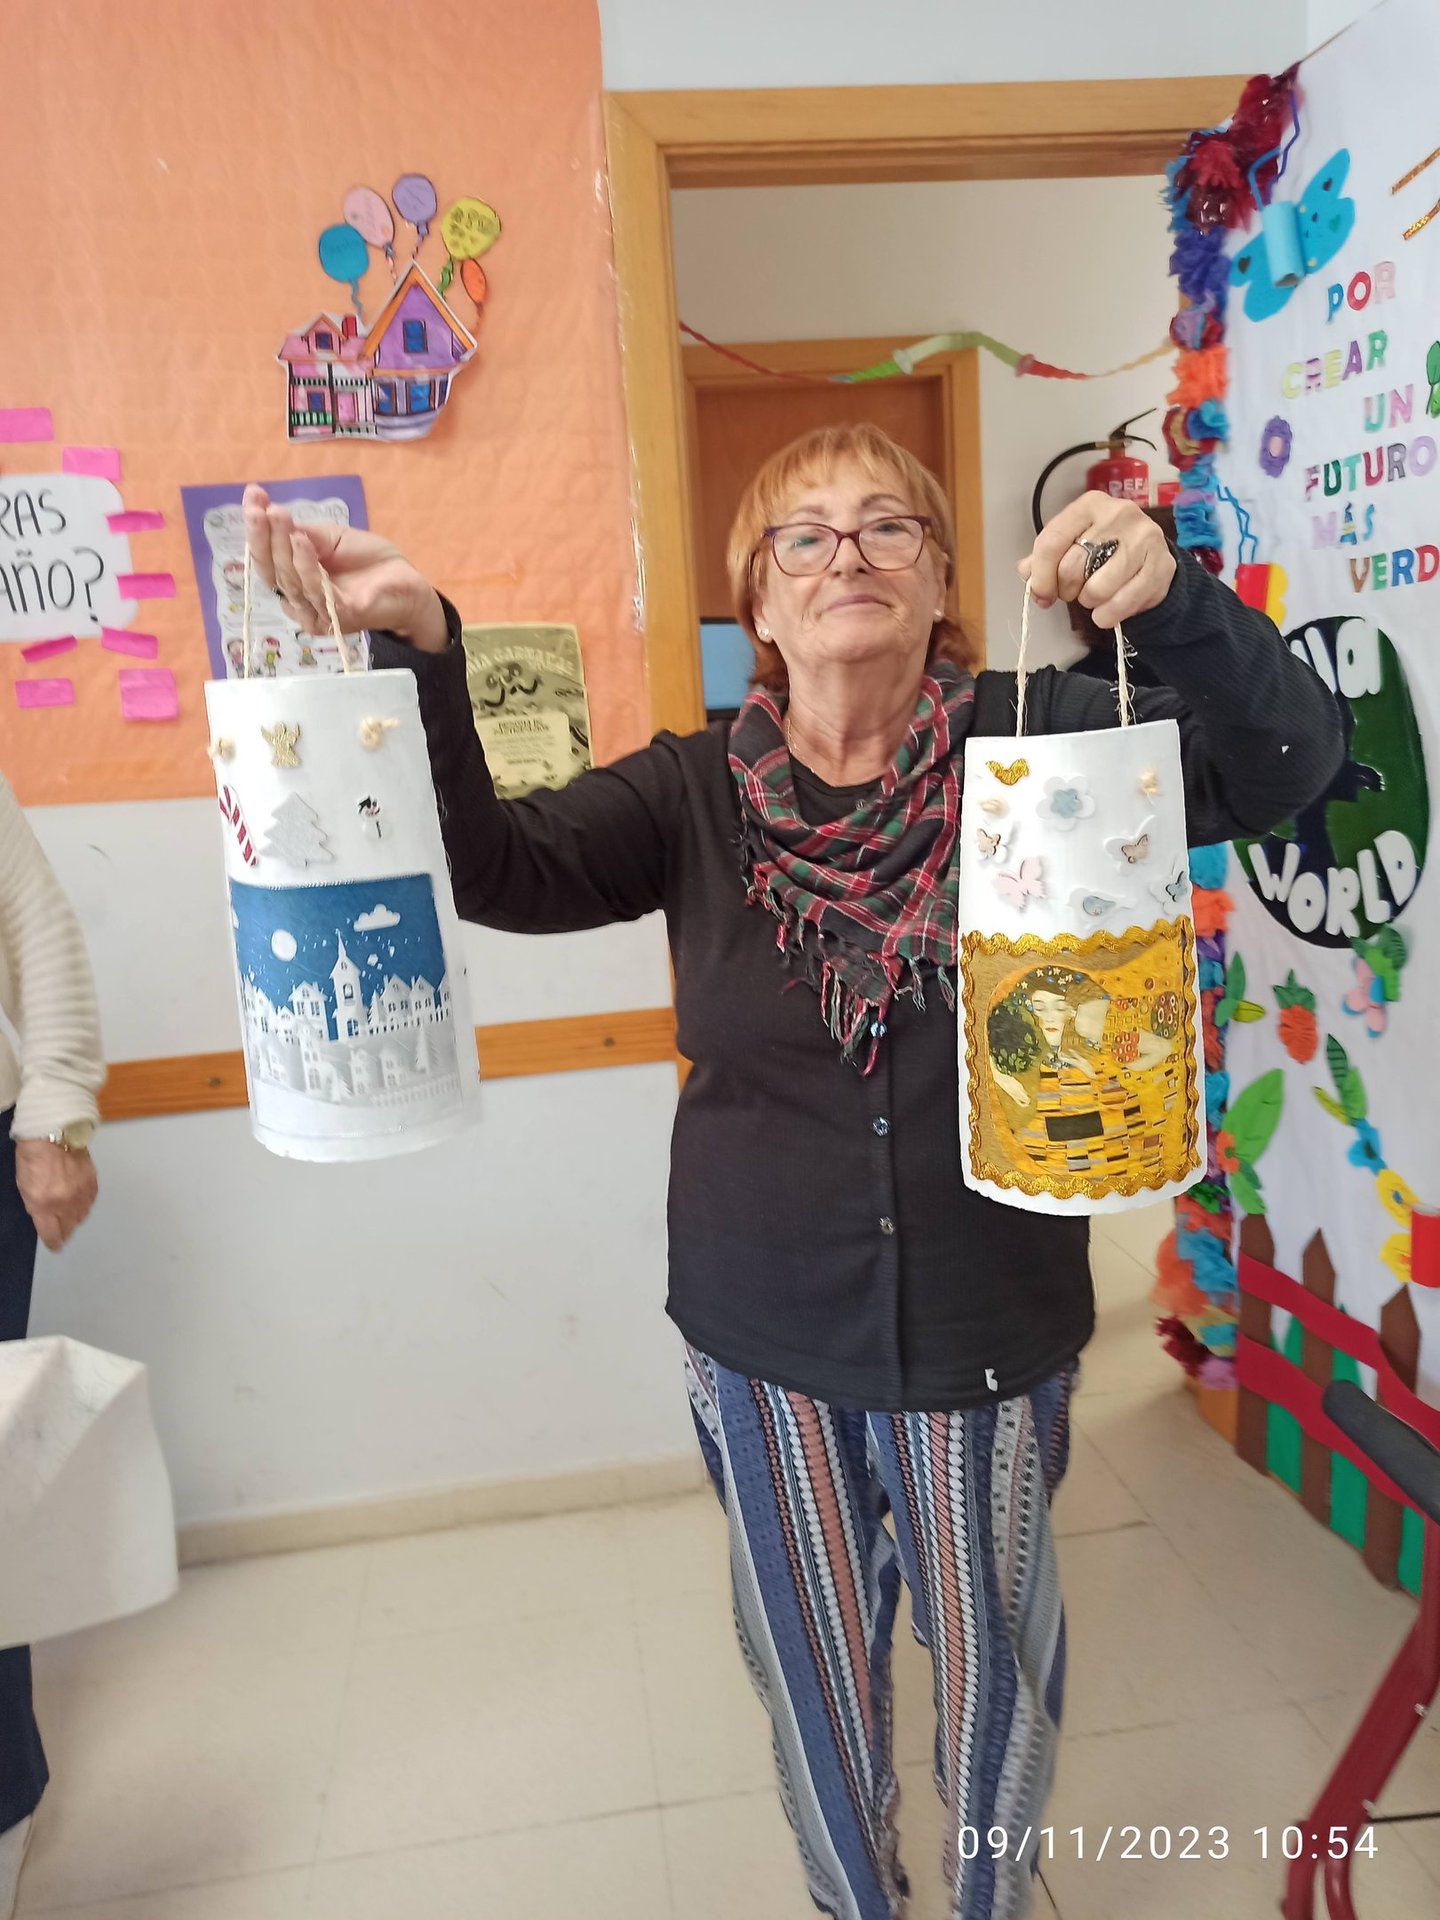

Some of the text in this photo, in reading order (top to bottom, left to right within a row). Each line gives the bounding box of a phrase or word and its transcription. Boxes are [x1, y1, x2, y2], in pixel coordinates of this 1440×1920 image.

[1326, 261, 1396, 323] POR
[1281, 330, 1388, 398] CREAR
[1364, 383, 1414, 433] UN
[1304, 435, 1438, 501] FUTURO
[1248, 830, 1417, 938] WORLD
